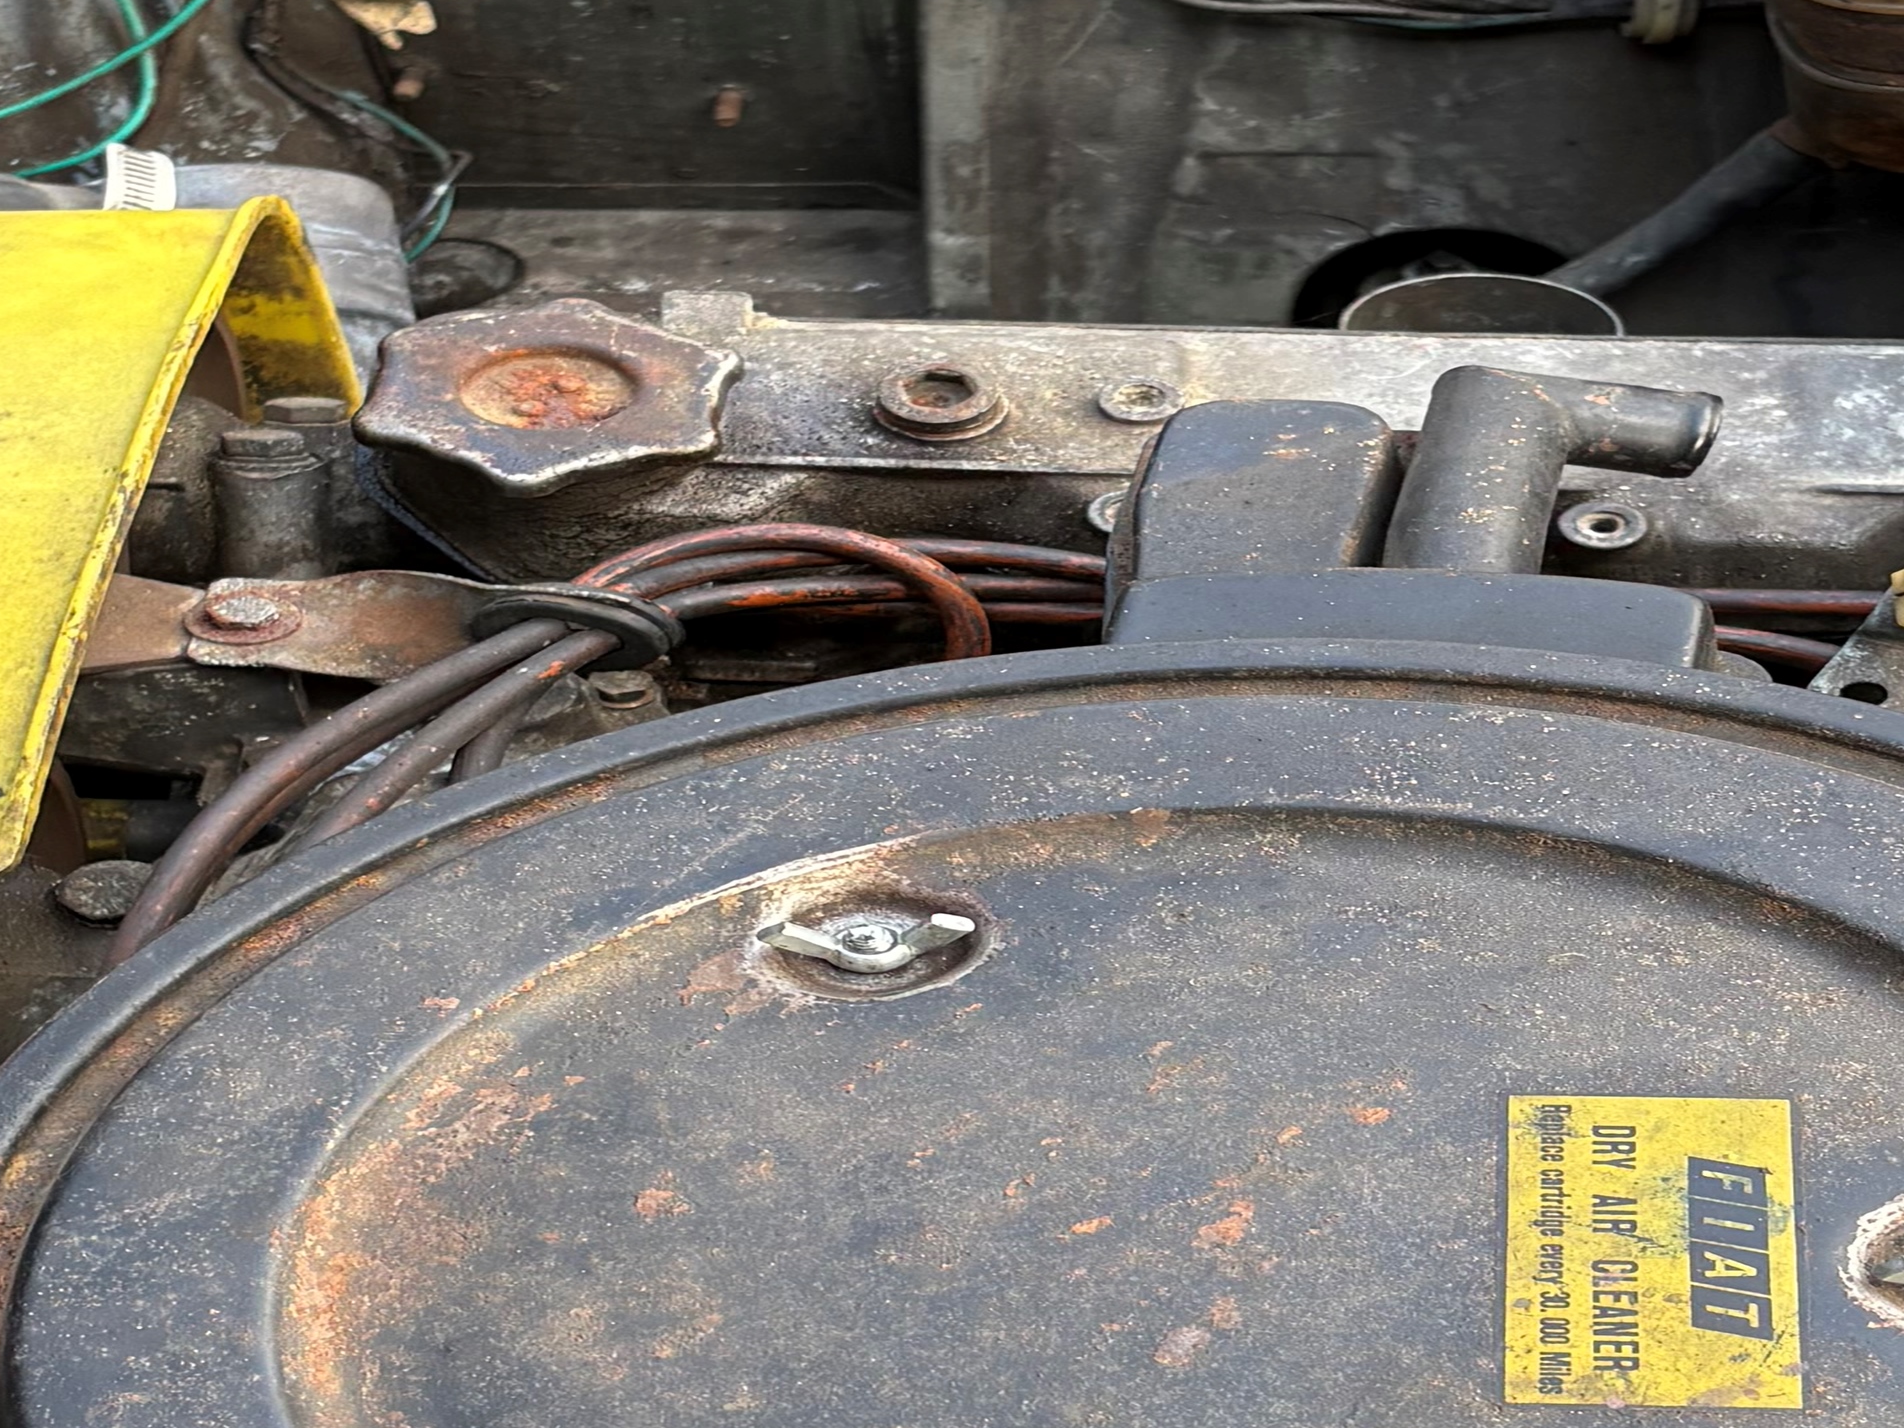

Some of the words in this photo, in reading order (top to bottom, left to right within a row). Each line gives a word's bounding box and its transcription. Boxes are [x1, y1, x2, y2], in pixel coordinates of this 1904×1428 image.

[1540, 1103, 1573, 1163] Replace
[1591, 1124, 1638, 1171] DRY
[1532, 1168, 1573, 1238] cartridge
[1591, 1193, 1639, 1234] AIR
[1533, 1243, 1566, 1286] every
[1695, 1165, 1765, 1333] FIAT
[1590, 1259, 1641, 1373] CLEANER
[1537, 1351, 1573, 1395] Miles
